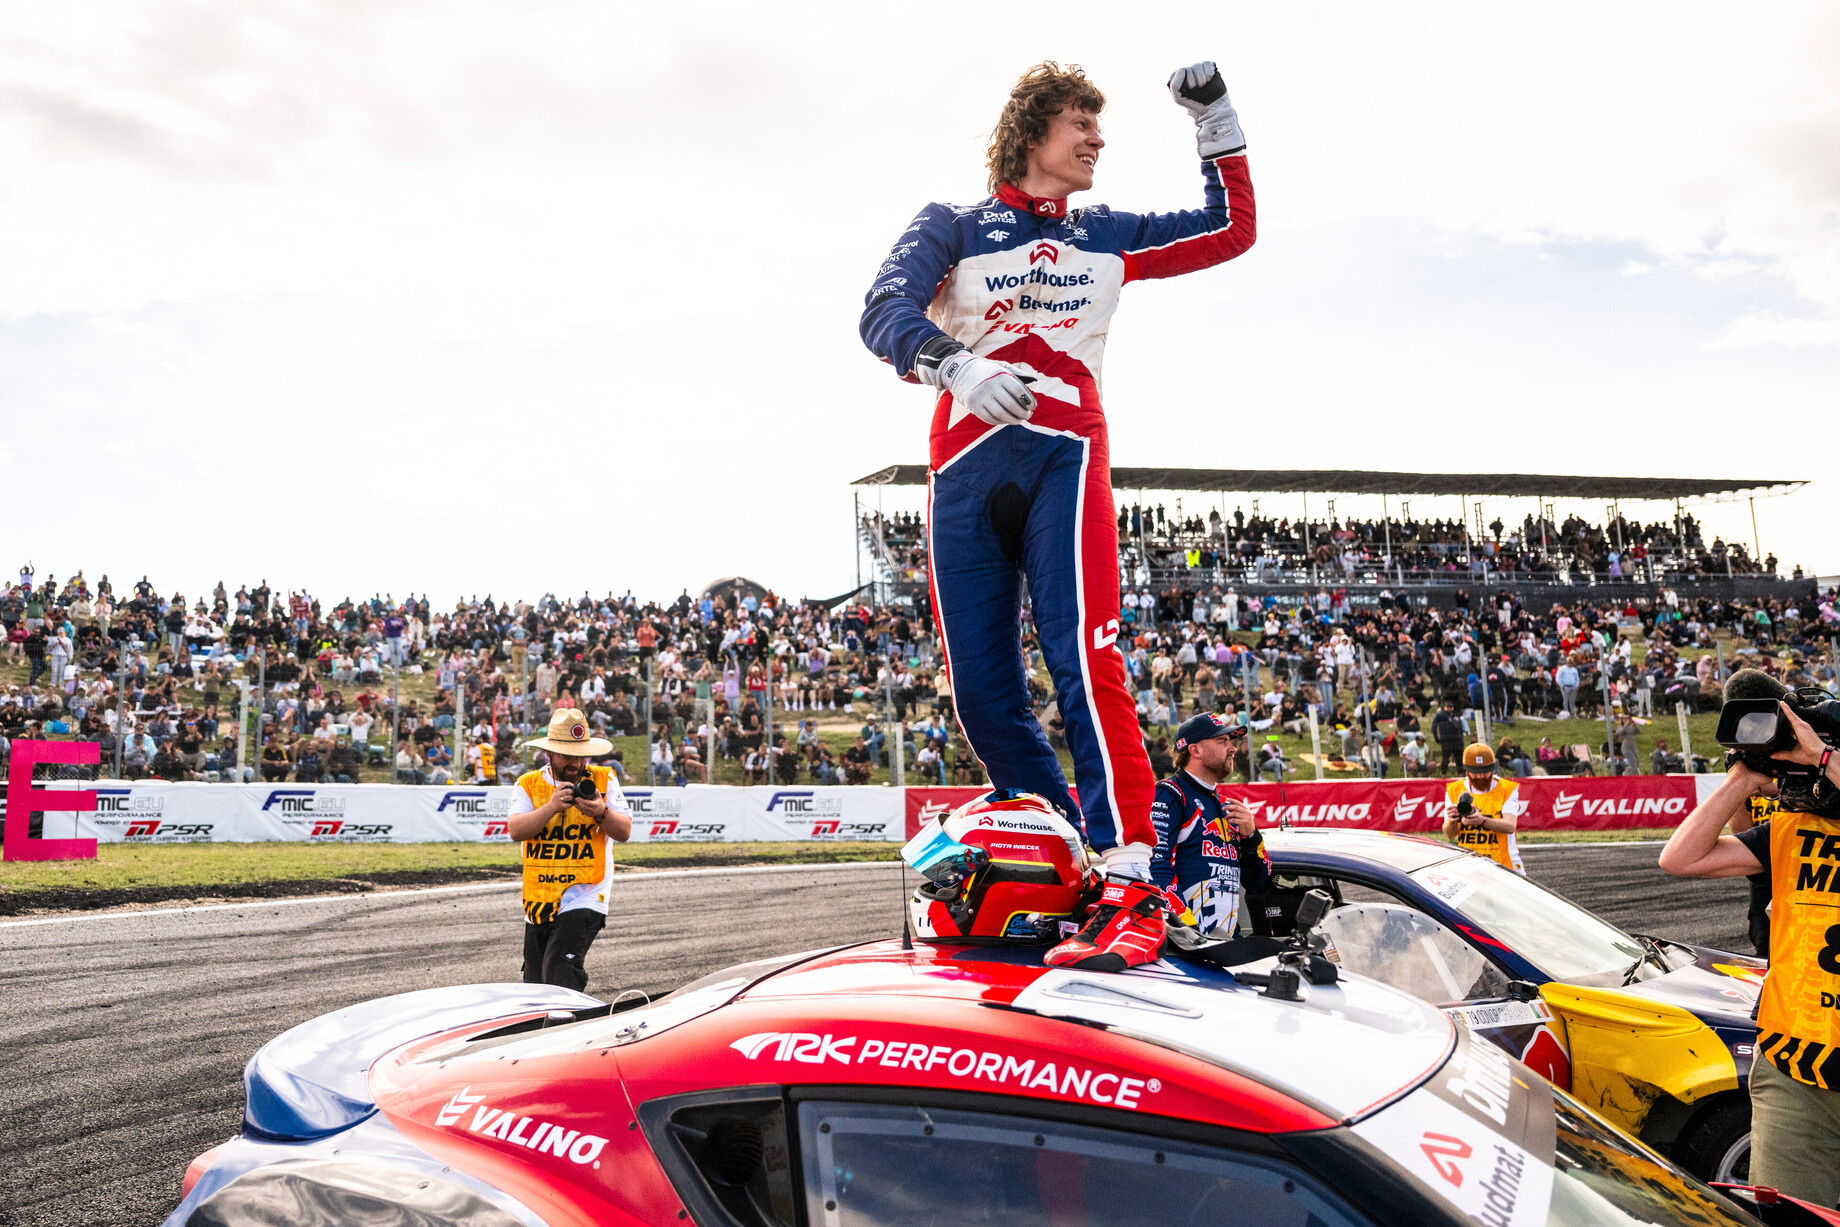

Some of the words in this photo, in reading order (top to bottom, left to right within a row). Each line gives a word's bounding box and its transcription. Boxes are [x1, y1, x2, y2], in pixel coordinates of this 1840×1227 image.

[978, 217, 1017, 225] MASTERS
[986, 229, 1010, 242] 4F
[3, 739, 100, 862] E
[88, 789, 163, 811] MIC.EU
[1582, 797, 1687, 816] VALINO
[1266, 803, 1372, 822] VALINO
[534, 823, 595, 841] RACK
[998, 820, 1056, 832] Worthouse.
[526, 842, 595, 860] MEDIA
[1202, 839, 1230, 860] Red
[1103, 889, 1125, 899] OMP
[469, 1104, 610, 1165] VALINO
[1468, 1144, 1525, 1227] udmat.
